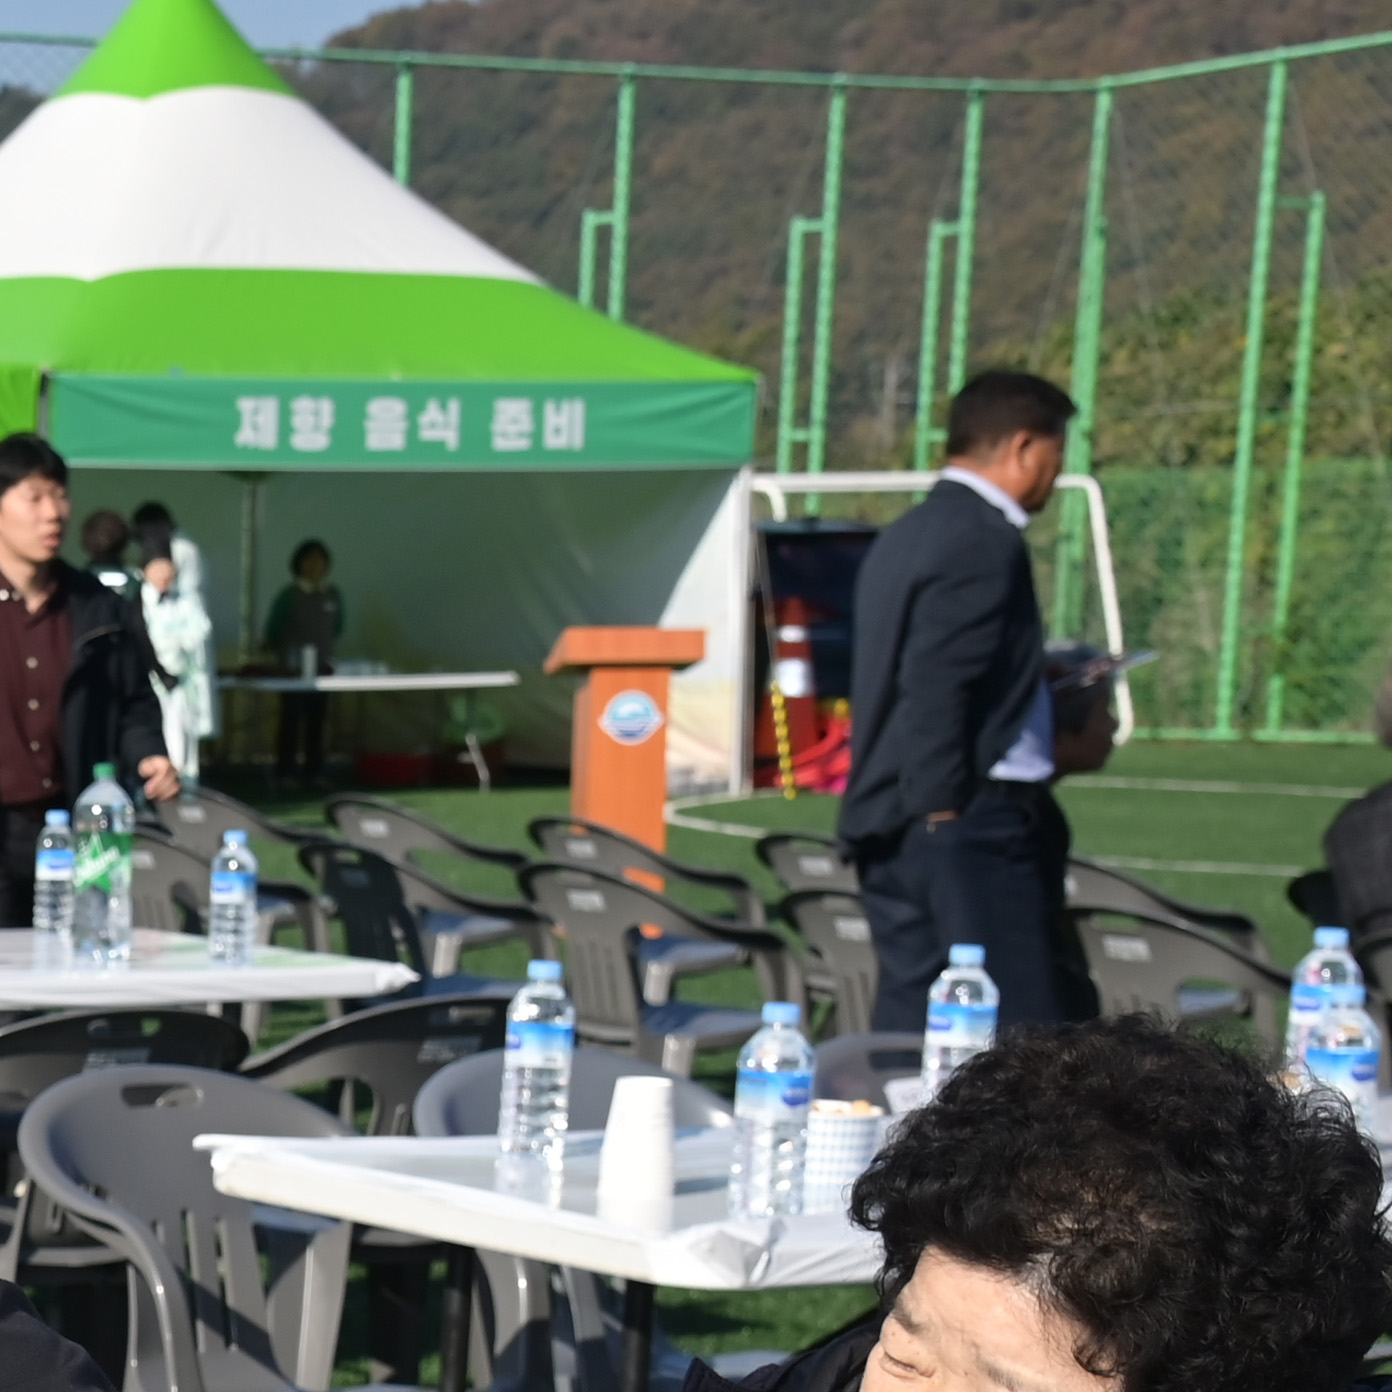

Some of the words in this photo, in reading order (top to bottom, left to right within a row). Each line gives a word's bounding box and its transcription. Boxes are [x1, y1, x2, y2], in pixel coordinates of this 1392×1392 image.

[234, 396, 335, 450] 제향
[364, 397, 460, 450] 음식
[490, 397, 586, 450] 준비
